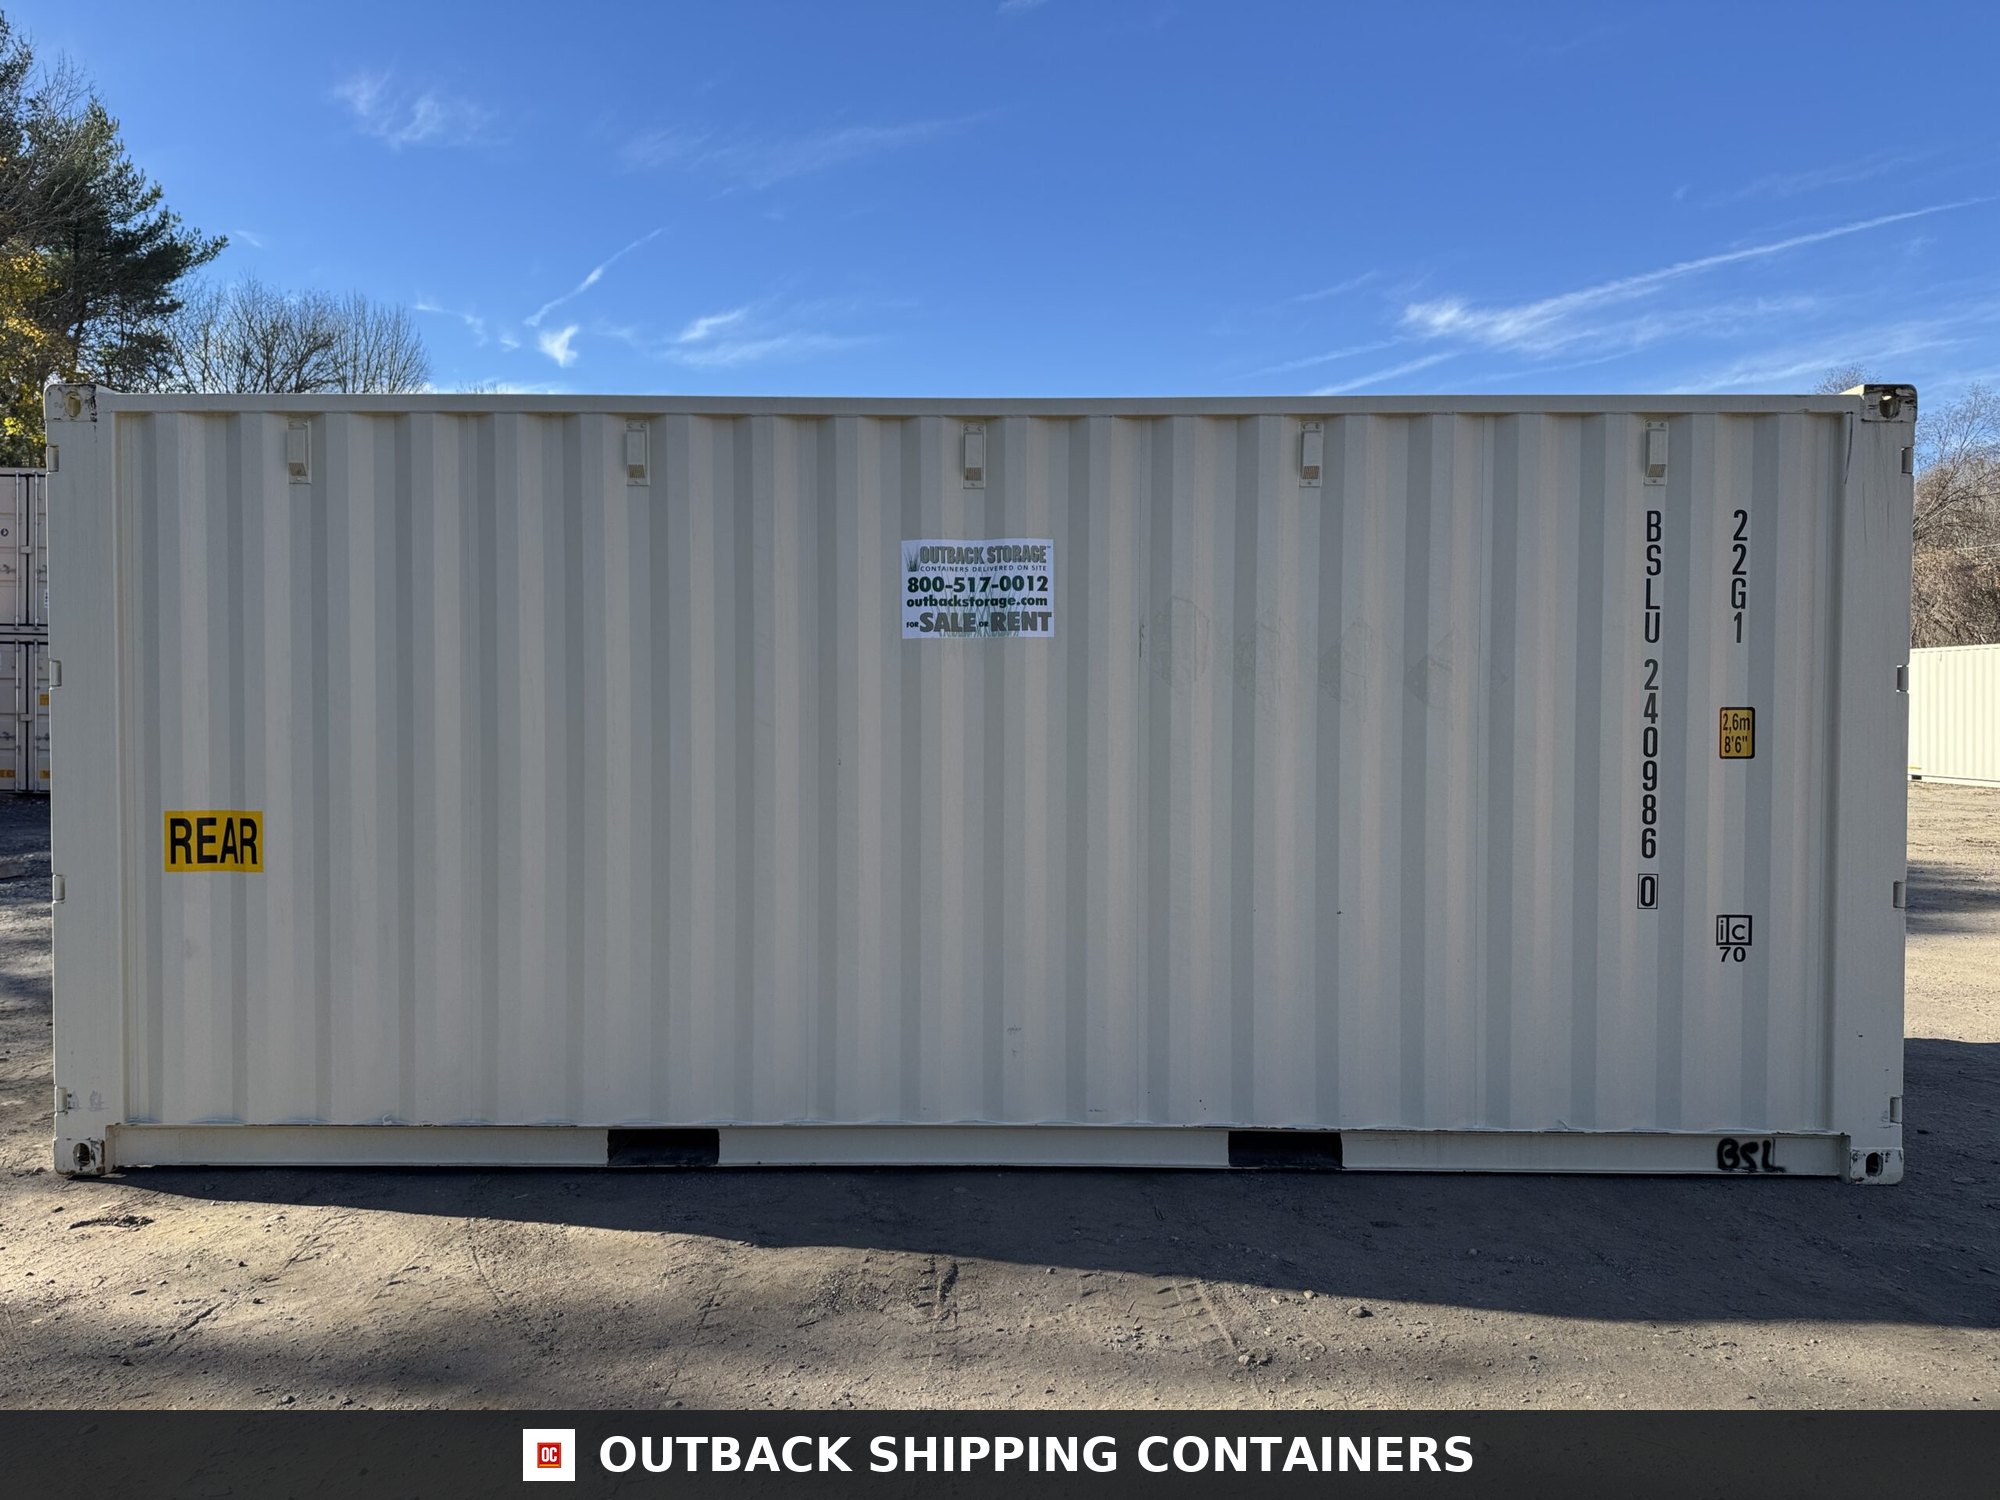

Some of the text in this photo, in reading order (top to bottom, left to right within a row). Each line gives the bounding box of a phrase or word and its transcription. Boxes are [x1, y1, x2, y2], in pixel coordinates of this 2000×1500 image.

[919, 544, 1047, 565] OUTBACK STORAGE
[920, 565, 969, 573] CONTAINERS
[972, 564, 1014, 573] DELIVERED
[1031, 564, 1047, 572] SITE
[1731, 509, 1748, 643] 22G1
[907, 575, 1048, 593] 800-517-0012
[906, 594, 1048, 608] outbackstorage.com
[919, 611, 976, 633] SALE
[991, 611, 1052, 632] RENT
[1640, 510, 1662, 907] BSLU 240986 0
[1724, 735, 1748, 753] 8'6"
[169, 817, 258, 864] REAR
[1719, 946, 1746, 962] 70
[1717, 1137, 1786, 1172] BSL
